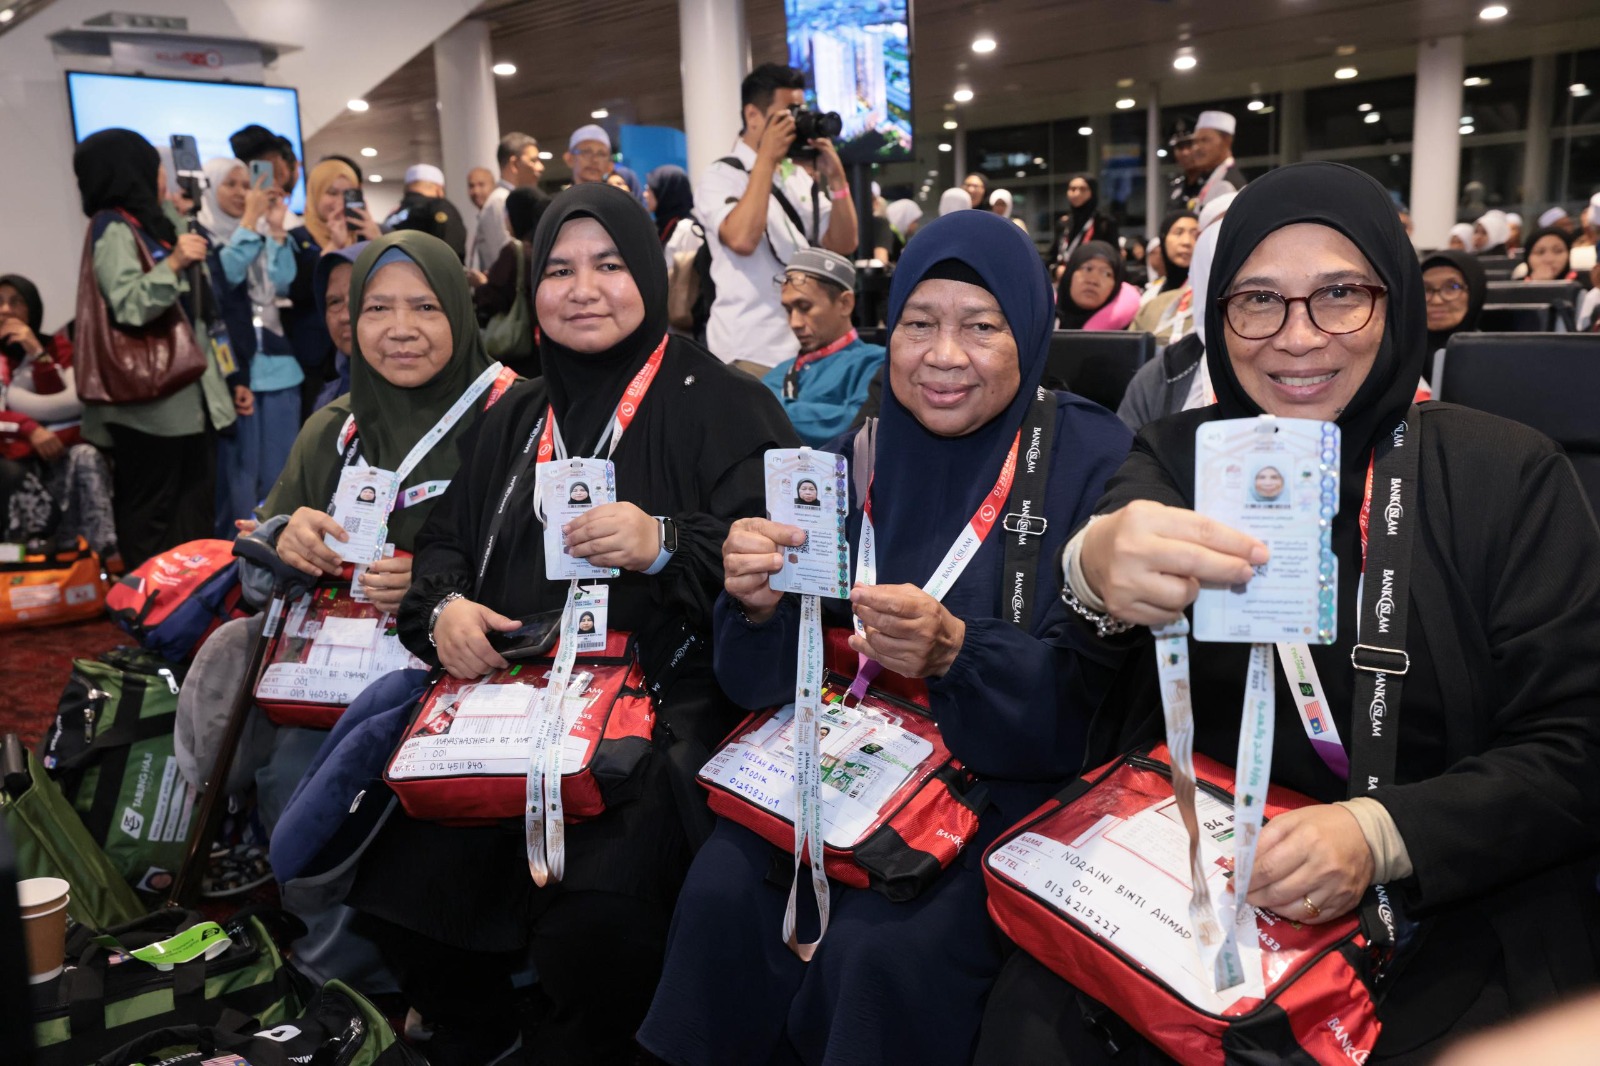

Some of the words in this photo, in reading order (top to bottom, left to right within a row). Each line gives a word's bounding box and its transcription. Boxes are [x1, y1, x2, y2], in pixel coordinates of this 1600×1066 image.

[1032, 427, 1042, 448] BANK
[1026, 447, 1040, 473] ISLAM
[993, 486, 1001, 496] 01
[1390, 477, 1402, 506] BANK
[1384, 502, 1404, 536] ISLAM
[940, 557, 958, 579] BANK
[952, 535, 975, 562] ISLAM
[1015, 571, 1024, 595] BANK
[1382, 568, 1394, 599] BANK
[1011, 594, 1024, 623] ISLAM
[1375, 596, 1395, 633] ISLAM
[293, 677, 308, 686] 001
[1366, 697, 1388, 737] ISLAM
[742, 750, 767, 768] MESAH
[767, 764, 788, 780] BINTI
[132, 768, 148, 808] TABUNG
[143, 752, 153, 772] HAJI
[1202, 817, 1224, 832] 84
[935, 829, 964, 848] BANK
[1004, 843, 1018, 854] NO
[1018, 846, 1030, 857] KT
[1018, 834, 1043, 848] NAMA
[992, 853, 1004, 863] NO
[1003, 858, 1018, 871] TEL
[1061, 850, 1113, 886] NORAINI
[1113, 883, 1147, 909] BINTI
[1150, 908, 1193, 941] AHMAD
[1071, 878, 1093, 897] 001
[1374, 883, 1388, 906] ANK
[1044, 880, 1121, 938] 0134215227
[1326, 1017, 1357, 1058] BANK
